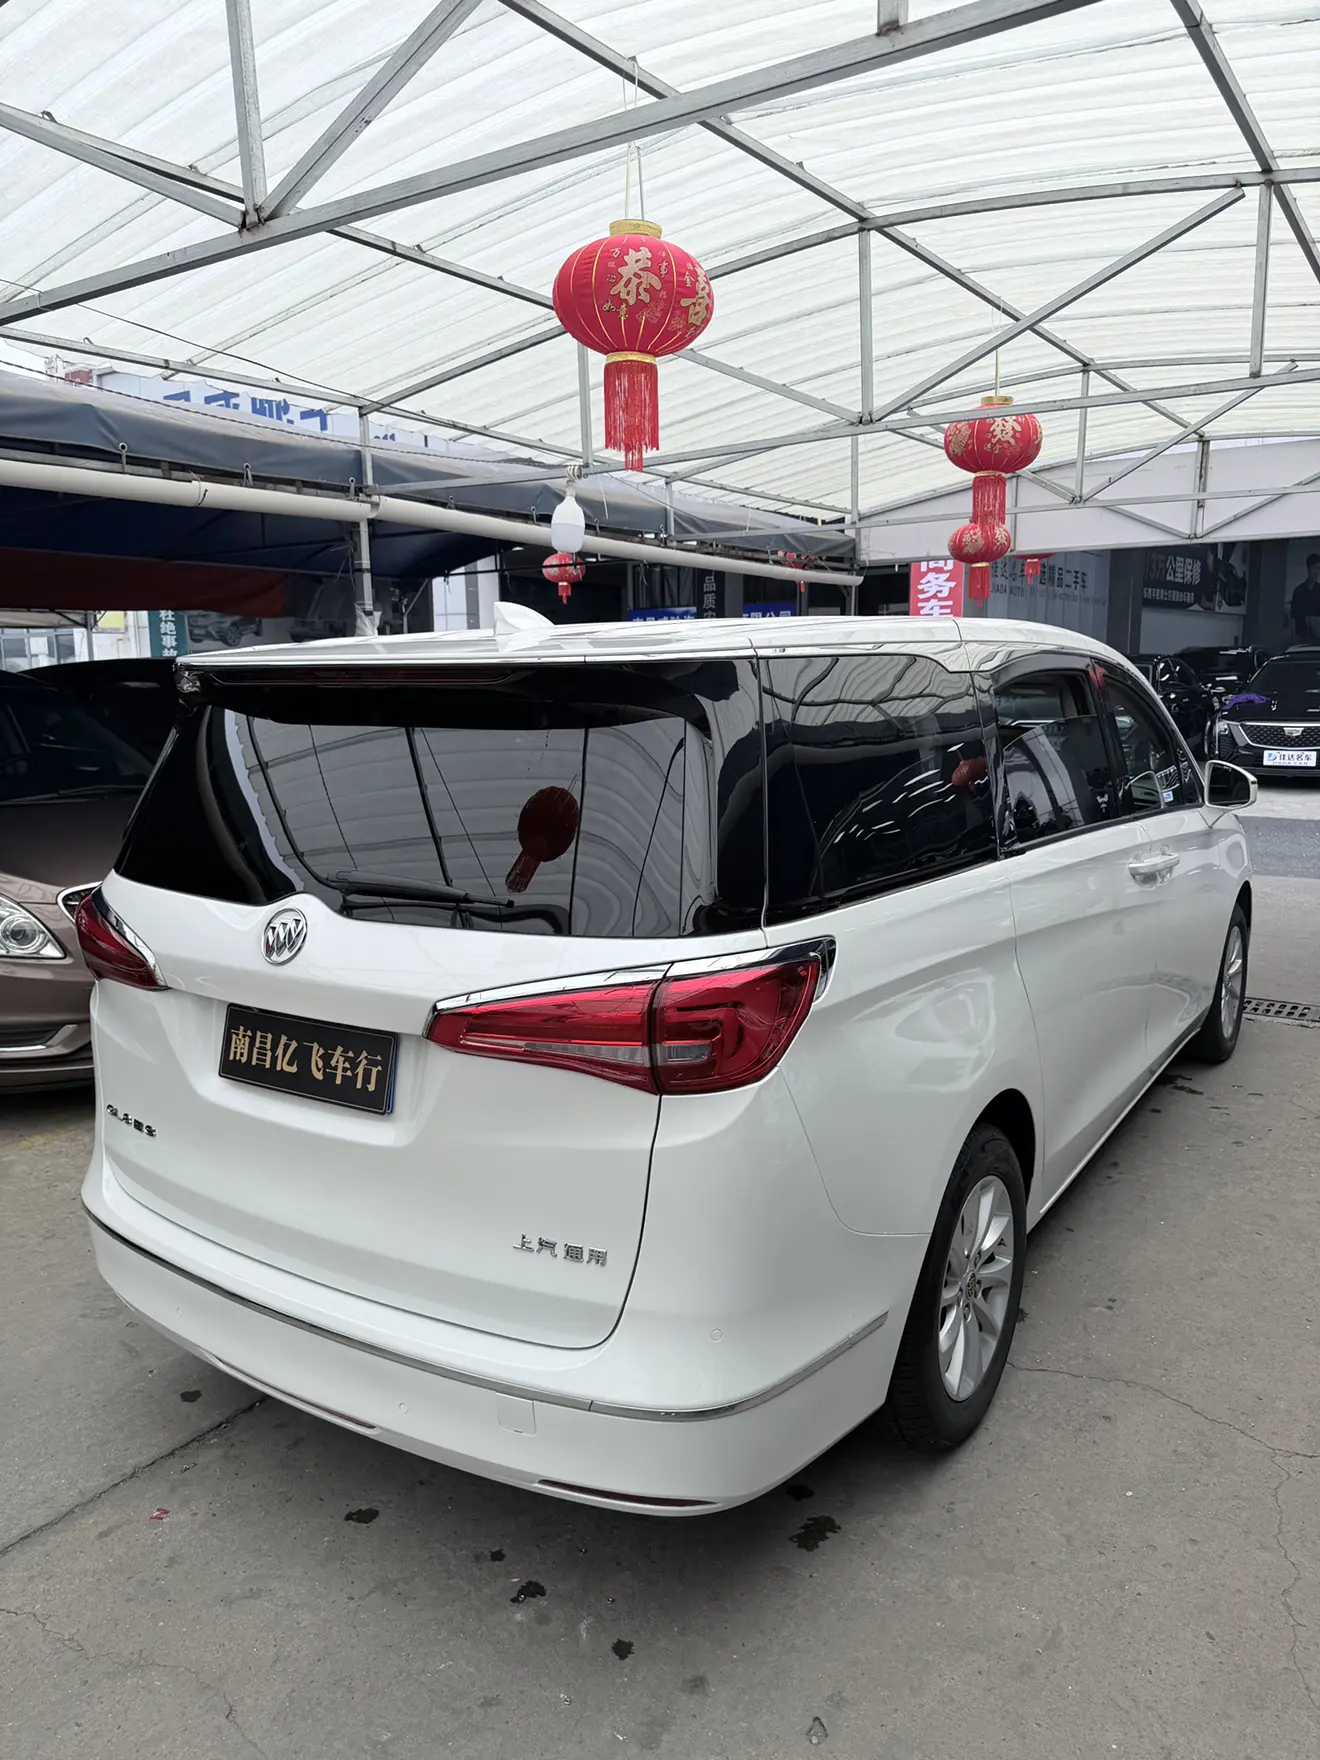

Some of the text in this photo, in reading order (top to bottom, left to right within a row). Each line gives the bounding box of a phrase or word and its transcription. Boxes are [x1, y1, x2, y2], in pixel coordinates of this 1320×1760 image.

[228, 1025, 383, 1092] 南昌亿飞车行
[512, 1233, 608, 1267] 上汽通用
